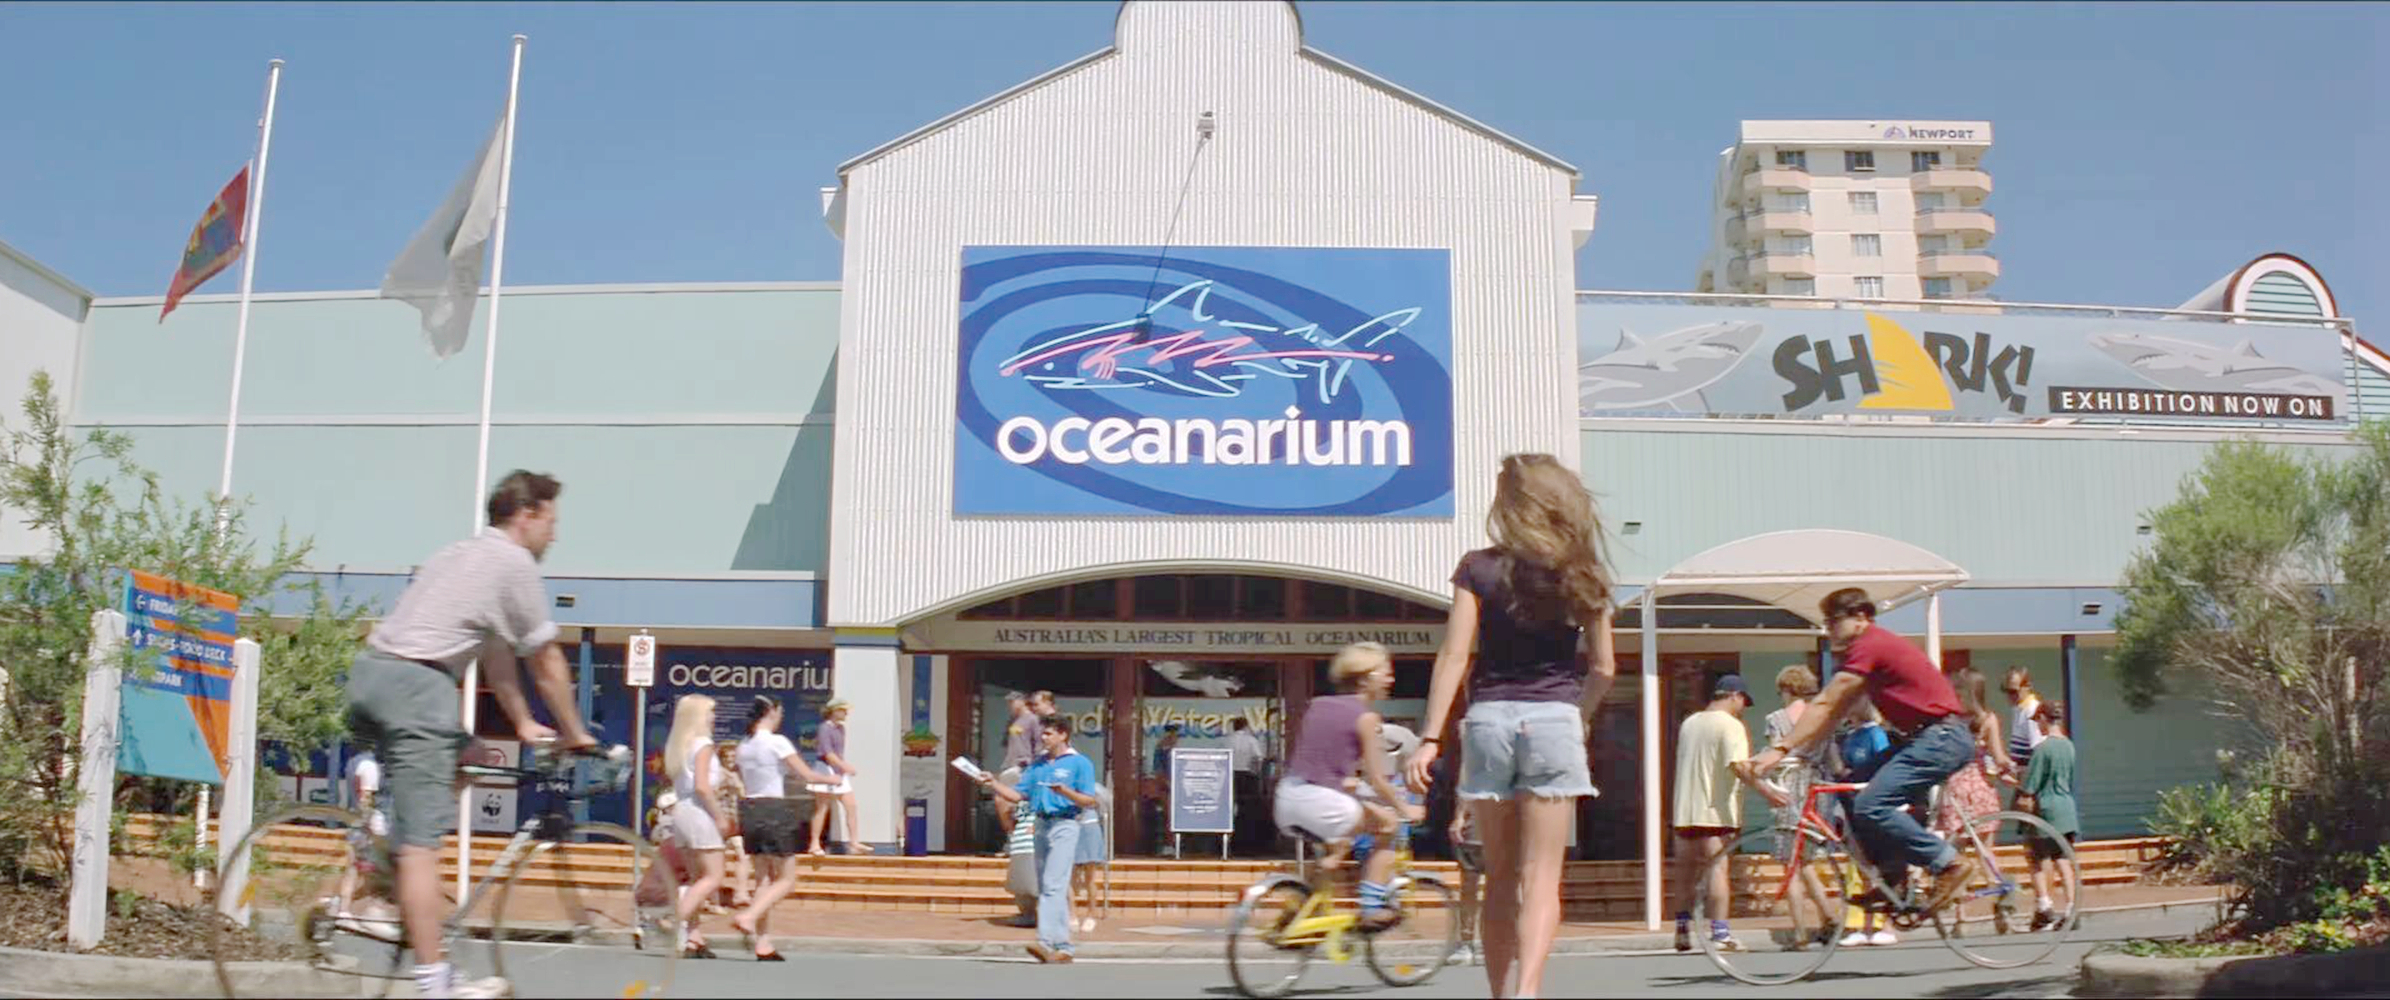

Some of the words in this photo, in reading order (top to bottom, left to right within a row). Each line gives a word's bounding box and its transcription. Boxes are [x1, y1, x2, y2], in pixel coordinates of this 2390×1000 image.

[1909, 128, 1974, 139] NEWPORT
[2061, 391, 2215, 412] EXHIBITION
[2224, 396, 2280, 415] NOW
[2289, 398, 2323, 416] ON
[997, 405, 1411, 466] oceanarium
[995, 629, 1107, 644] AUSTRALIA'S
[1114, 630, 1196, 645] LARGEST
[1204, 631, 1295, 646] TROPICAL
[1305, 631, 1431, 646] OCEANARIUM
[668, 660, 834, 690] oceanariu
[1142, 705, 1237, 734] Water
